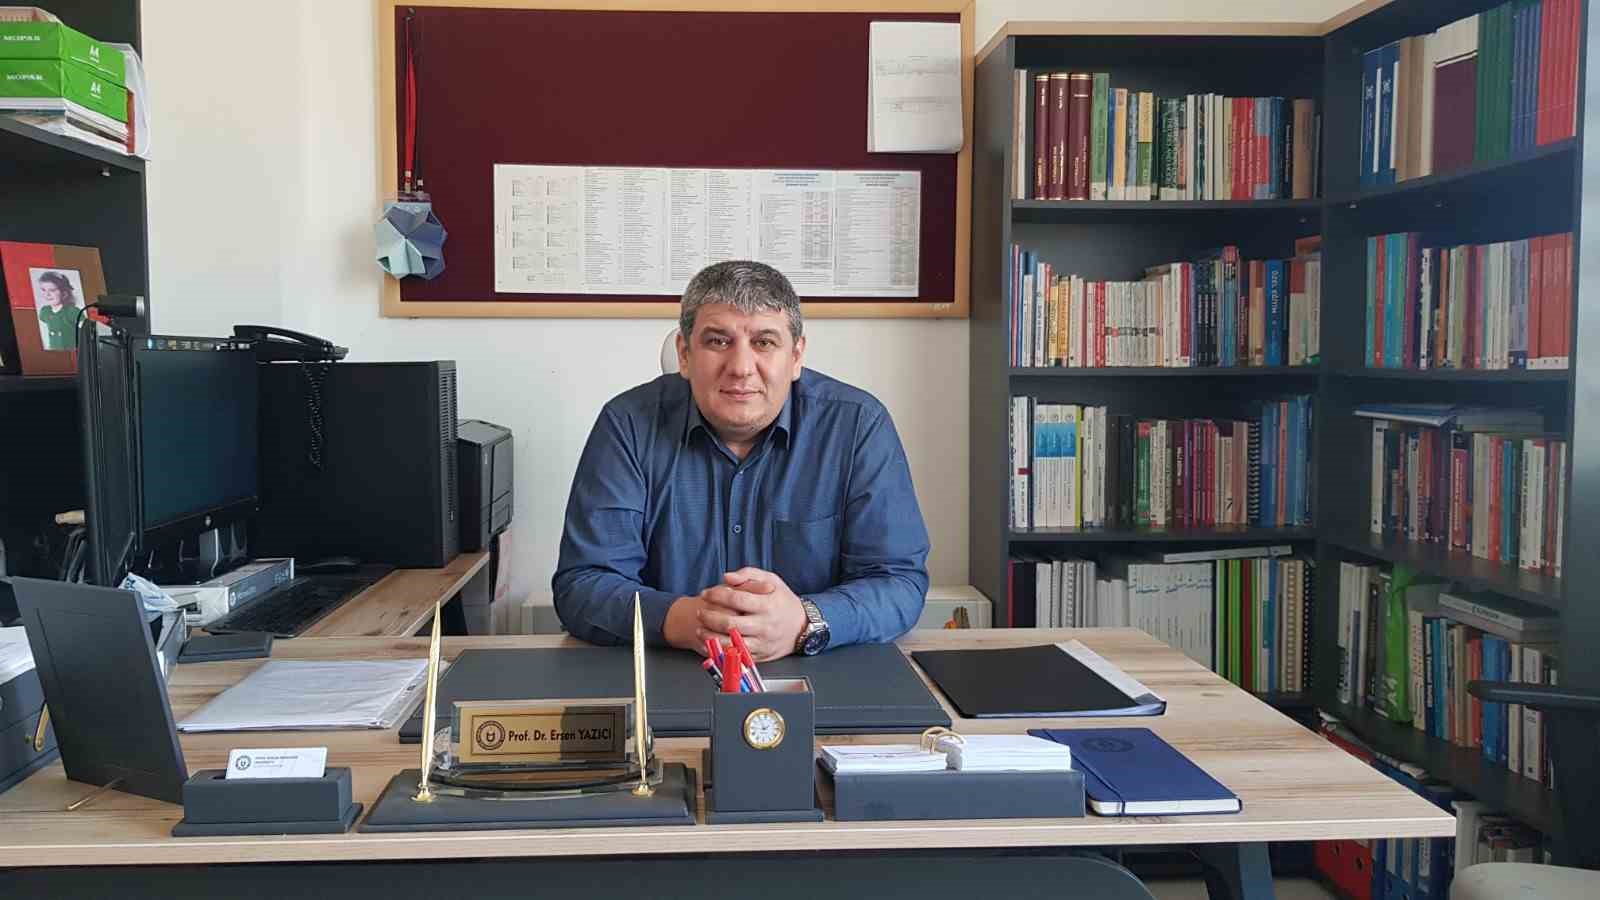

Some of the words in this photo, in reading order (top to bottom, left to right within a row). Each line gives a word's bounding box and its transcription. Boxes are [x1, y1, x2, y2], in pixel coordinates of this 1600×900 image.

[89, 44, 100, 58] A4
[90, 81, 101, 95] A4
[508, 730, 531, 741] Prof.
[534, 729, 548, 741] Dr.
[550, 729, 576, 741] Ersen
[577, 727, 612, 740] YAZICI
